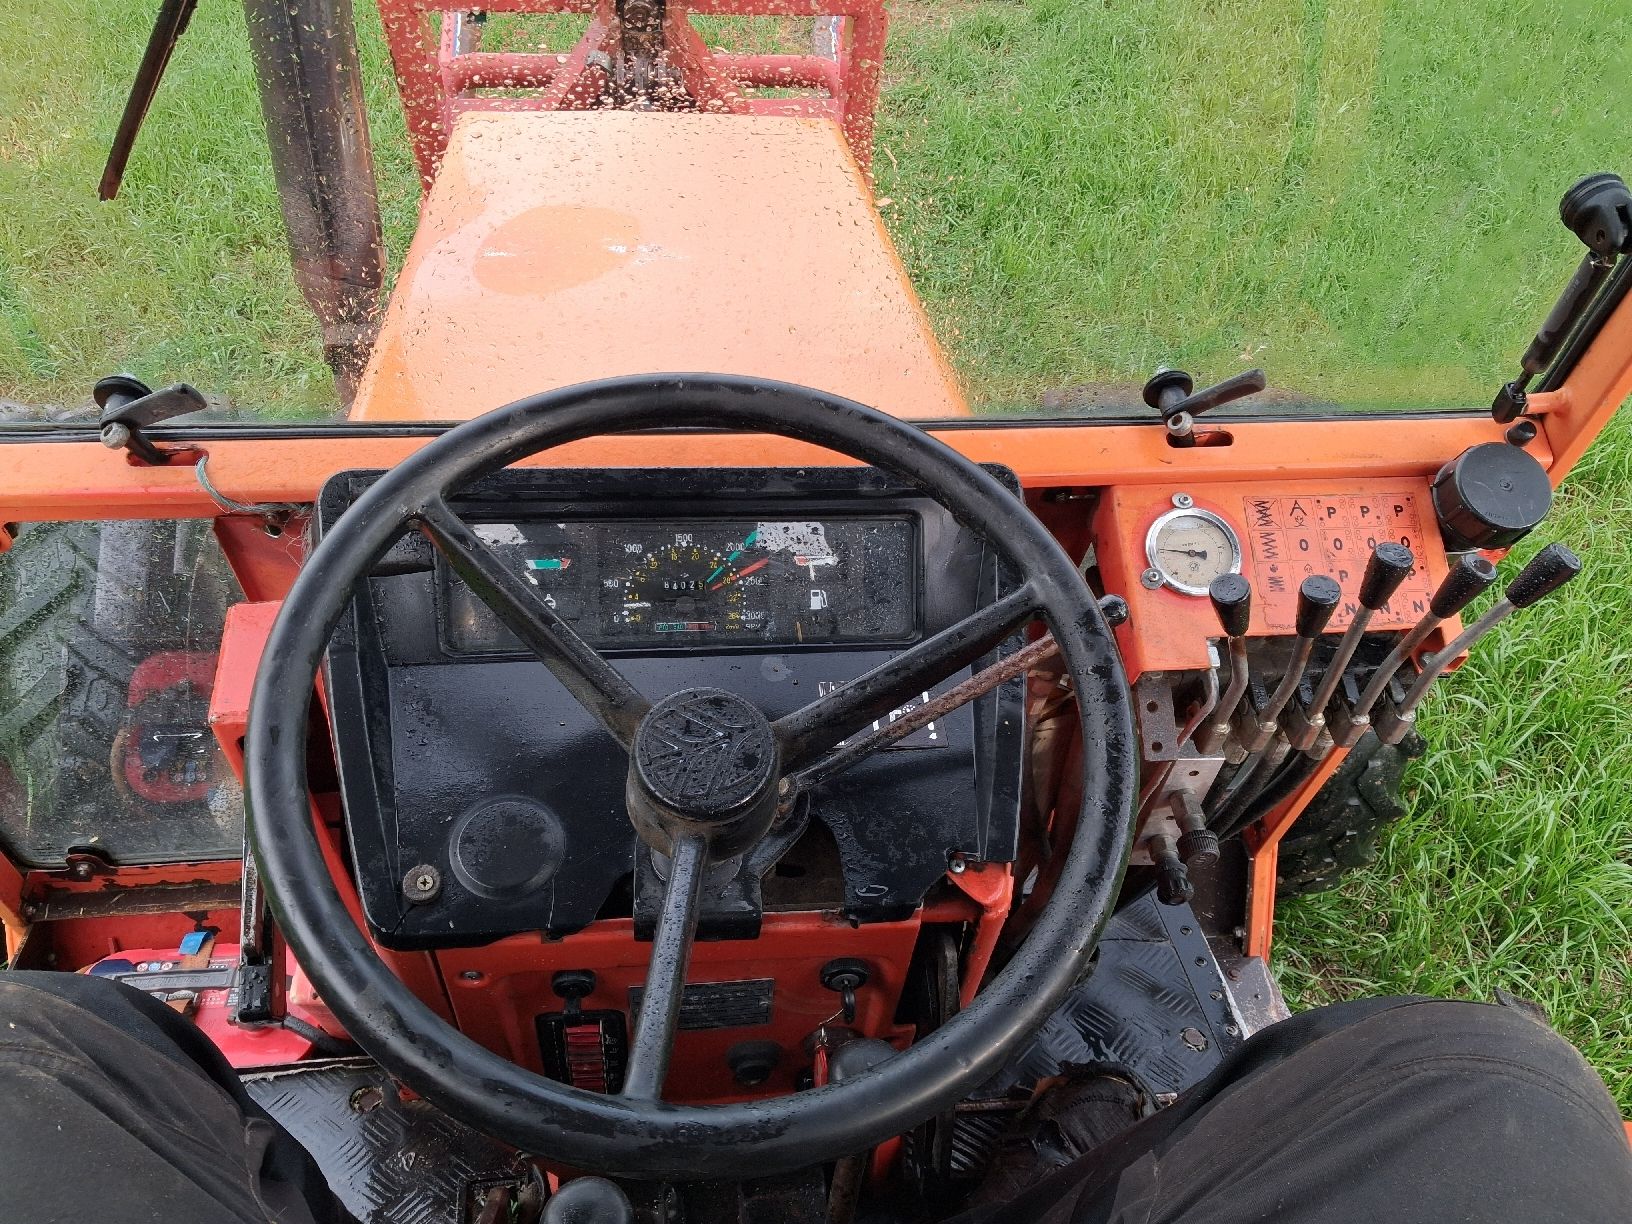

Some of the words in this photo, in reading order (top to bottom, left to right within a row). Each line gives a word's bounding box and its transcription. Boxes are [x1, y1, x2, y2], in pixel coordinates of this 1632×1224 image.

[1327, 507, 1337, 518] P
[1360, 506, 1370, 518] P
[1393, 505, 1403, 517] P
[675, 533, 693, 542] 1500
[725, 542, 745, 551] 2000
[1339, 570, 1348, 582] P
[603, 579, 619, 588] 500
[1413, 600, 1424, 613] N
